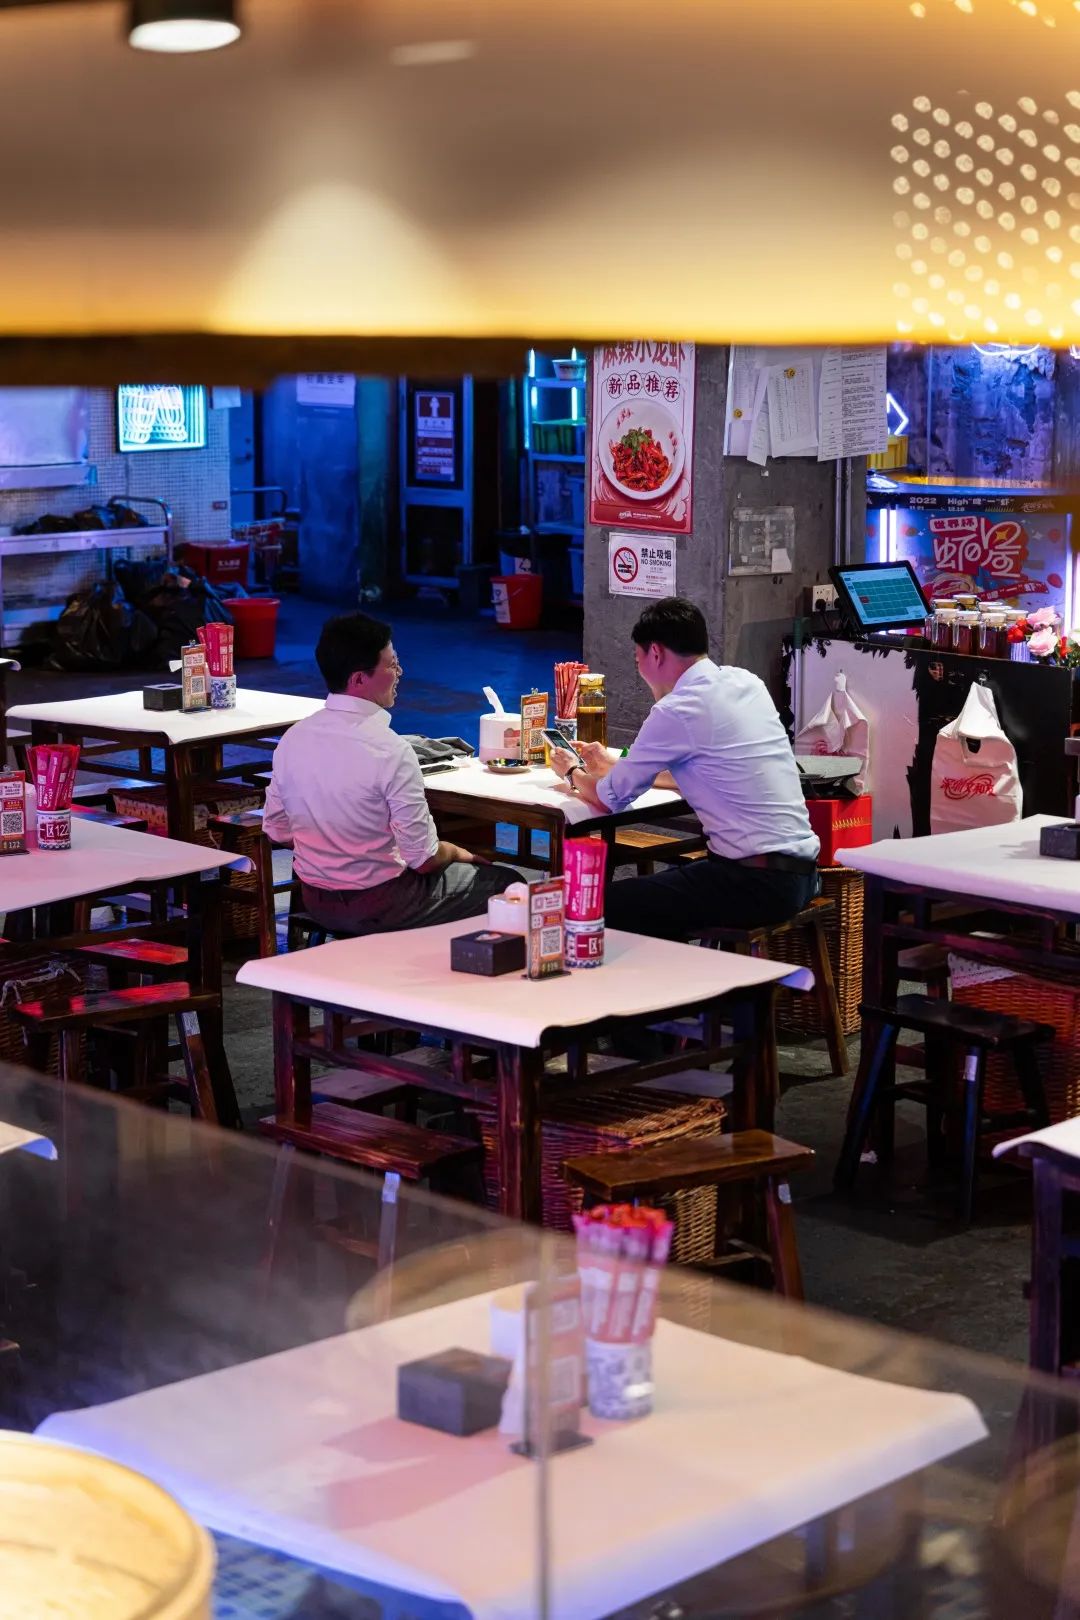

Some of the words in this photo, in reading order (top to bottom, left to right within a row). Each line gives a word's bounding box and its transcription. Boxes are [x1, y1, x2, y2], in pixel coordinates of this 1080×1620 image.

[608, 374, 679, 399] 新品推荐
[909, 496, 937, 505] 2022
[933, 516, 975, 530] 世界杯
[641, 547, 672, 560] 禁止吸烟
[649, 559, 672, 567] SMOKING
